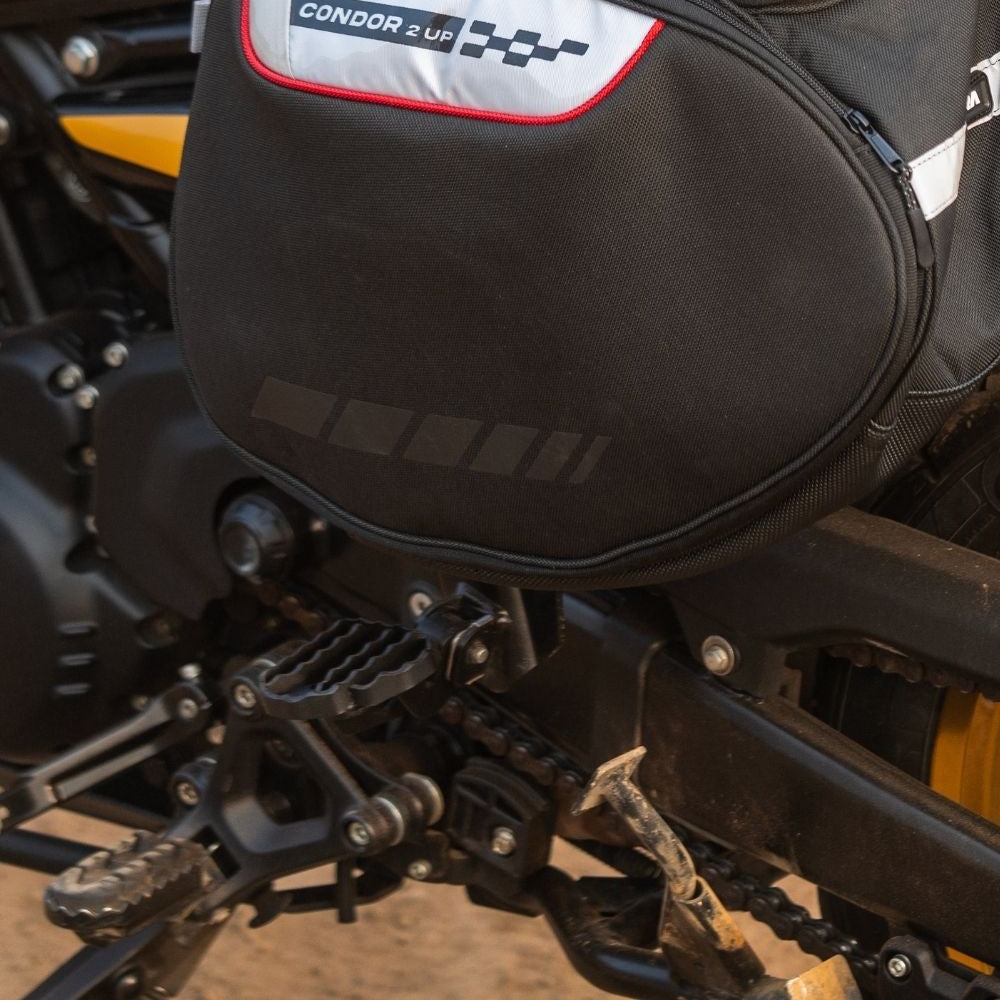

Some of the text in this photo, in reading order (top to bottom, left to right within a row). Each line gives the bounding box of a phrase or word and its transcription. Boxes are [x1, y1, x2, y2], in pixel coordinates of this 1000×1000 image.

[298, 2, 455, 43] CONDOR 2 UP
